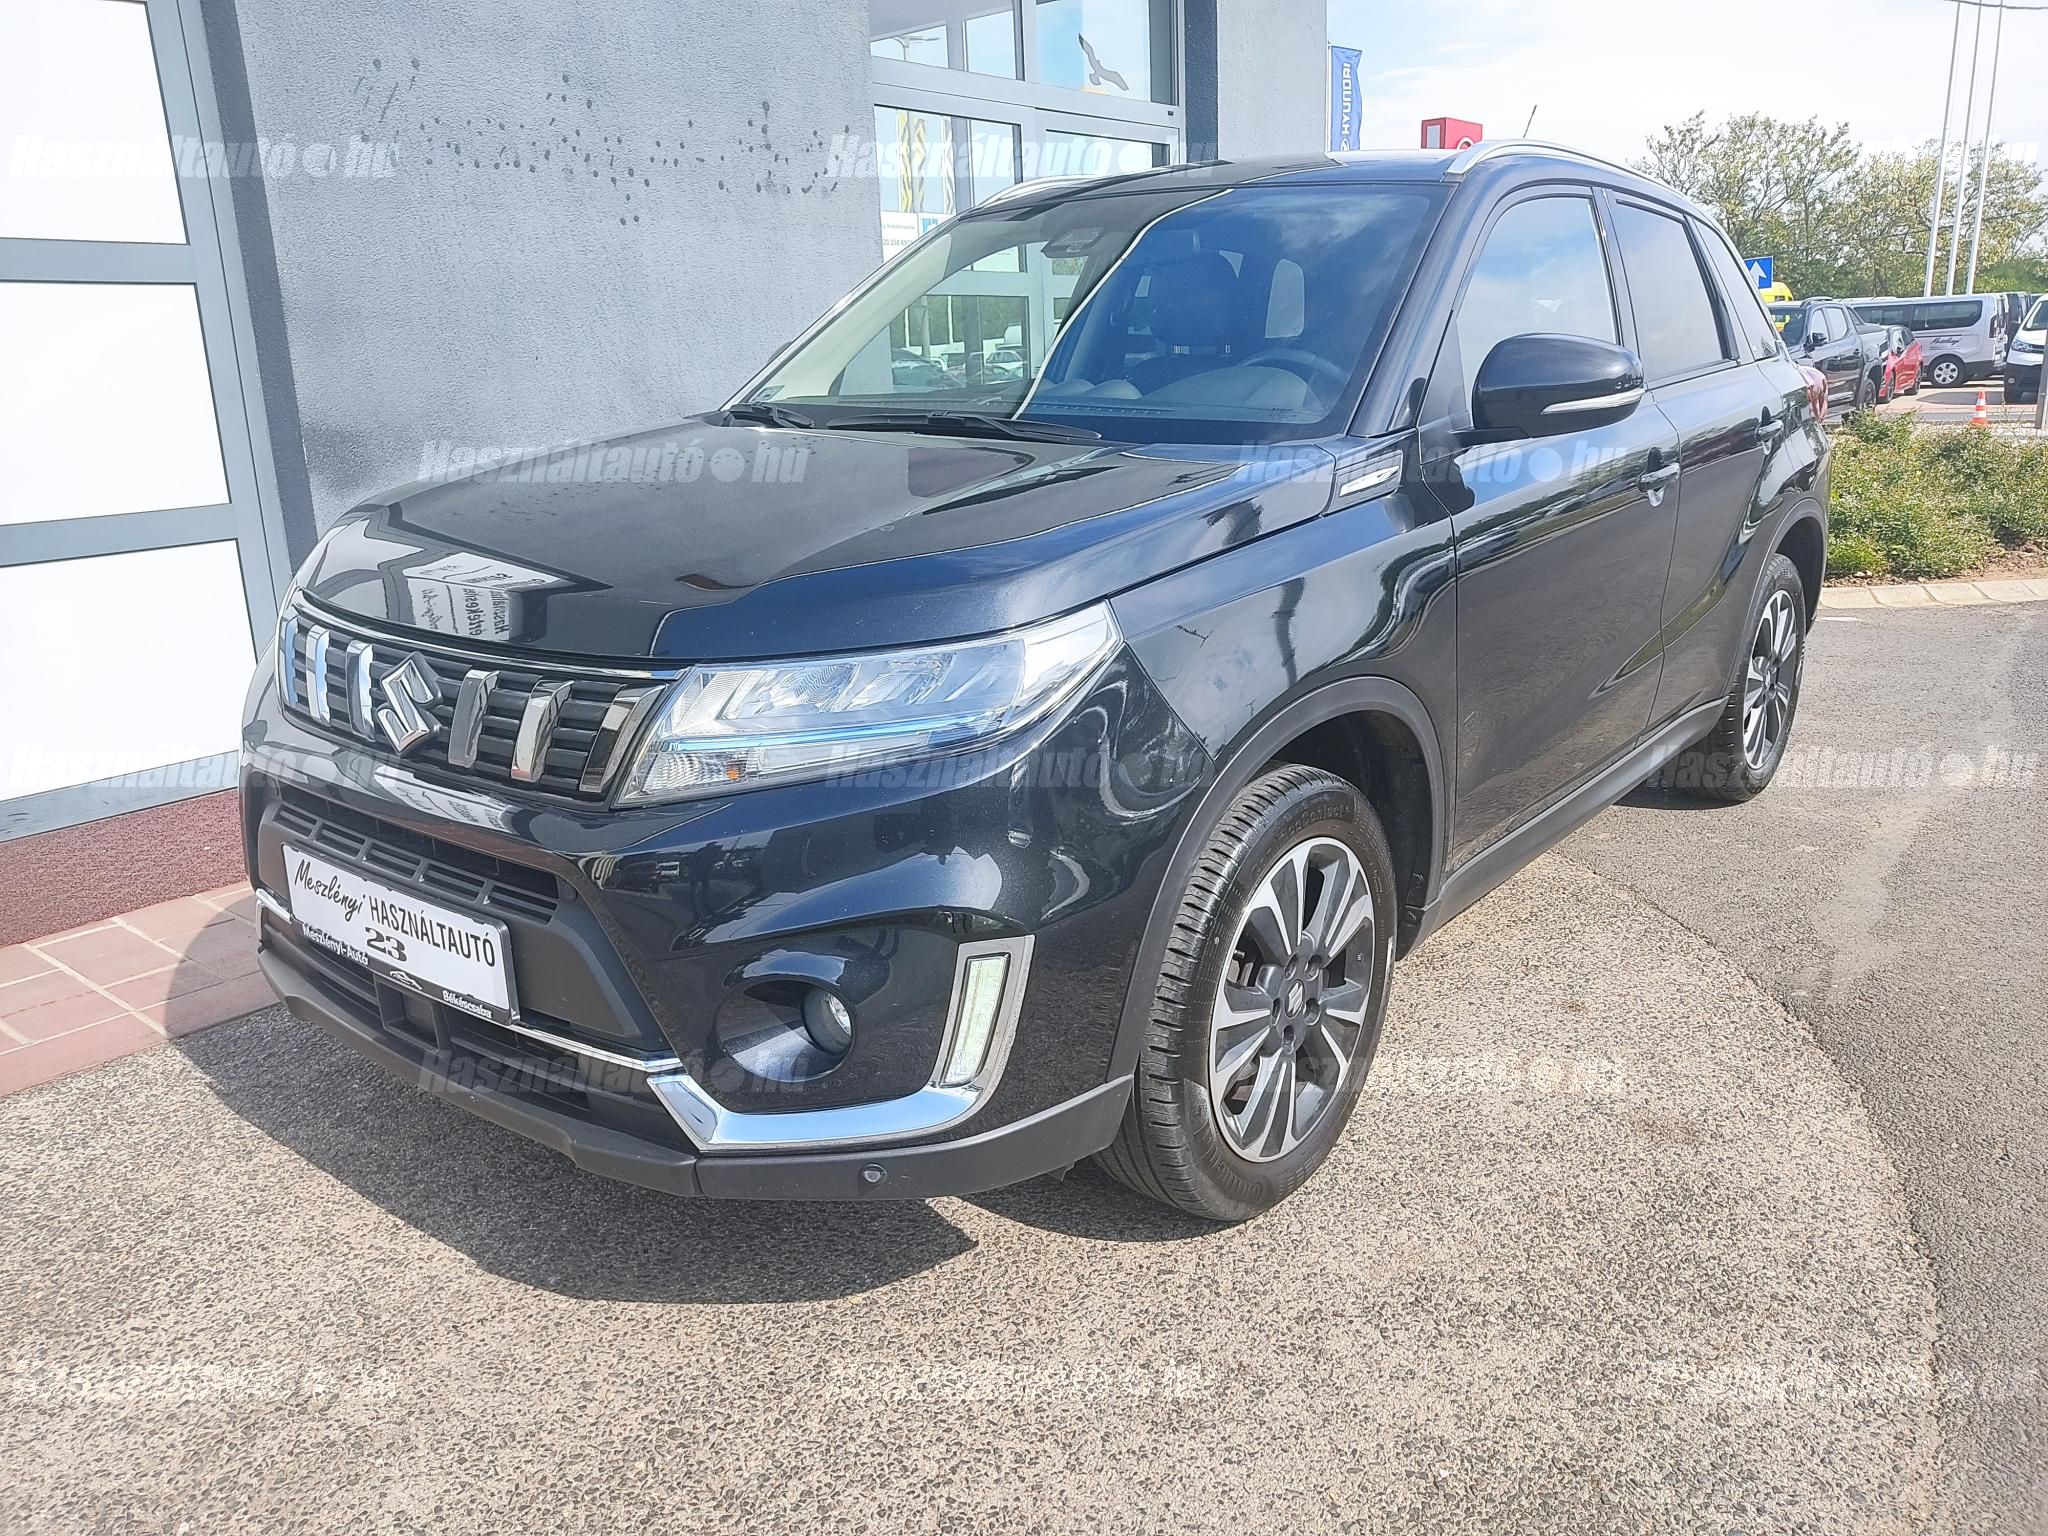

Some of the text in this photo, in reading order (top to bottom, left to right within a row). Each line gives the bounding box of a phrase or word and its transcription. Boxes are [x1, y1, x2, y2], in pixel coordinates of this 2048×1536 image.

[1342, 62, 1352, 135] HYUNDAI
[294, 859, 496, 968] Meszlényi HASZNÁLTAUTÓ
[365, 926, 408, 962] 23
